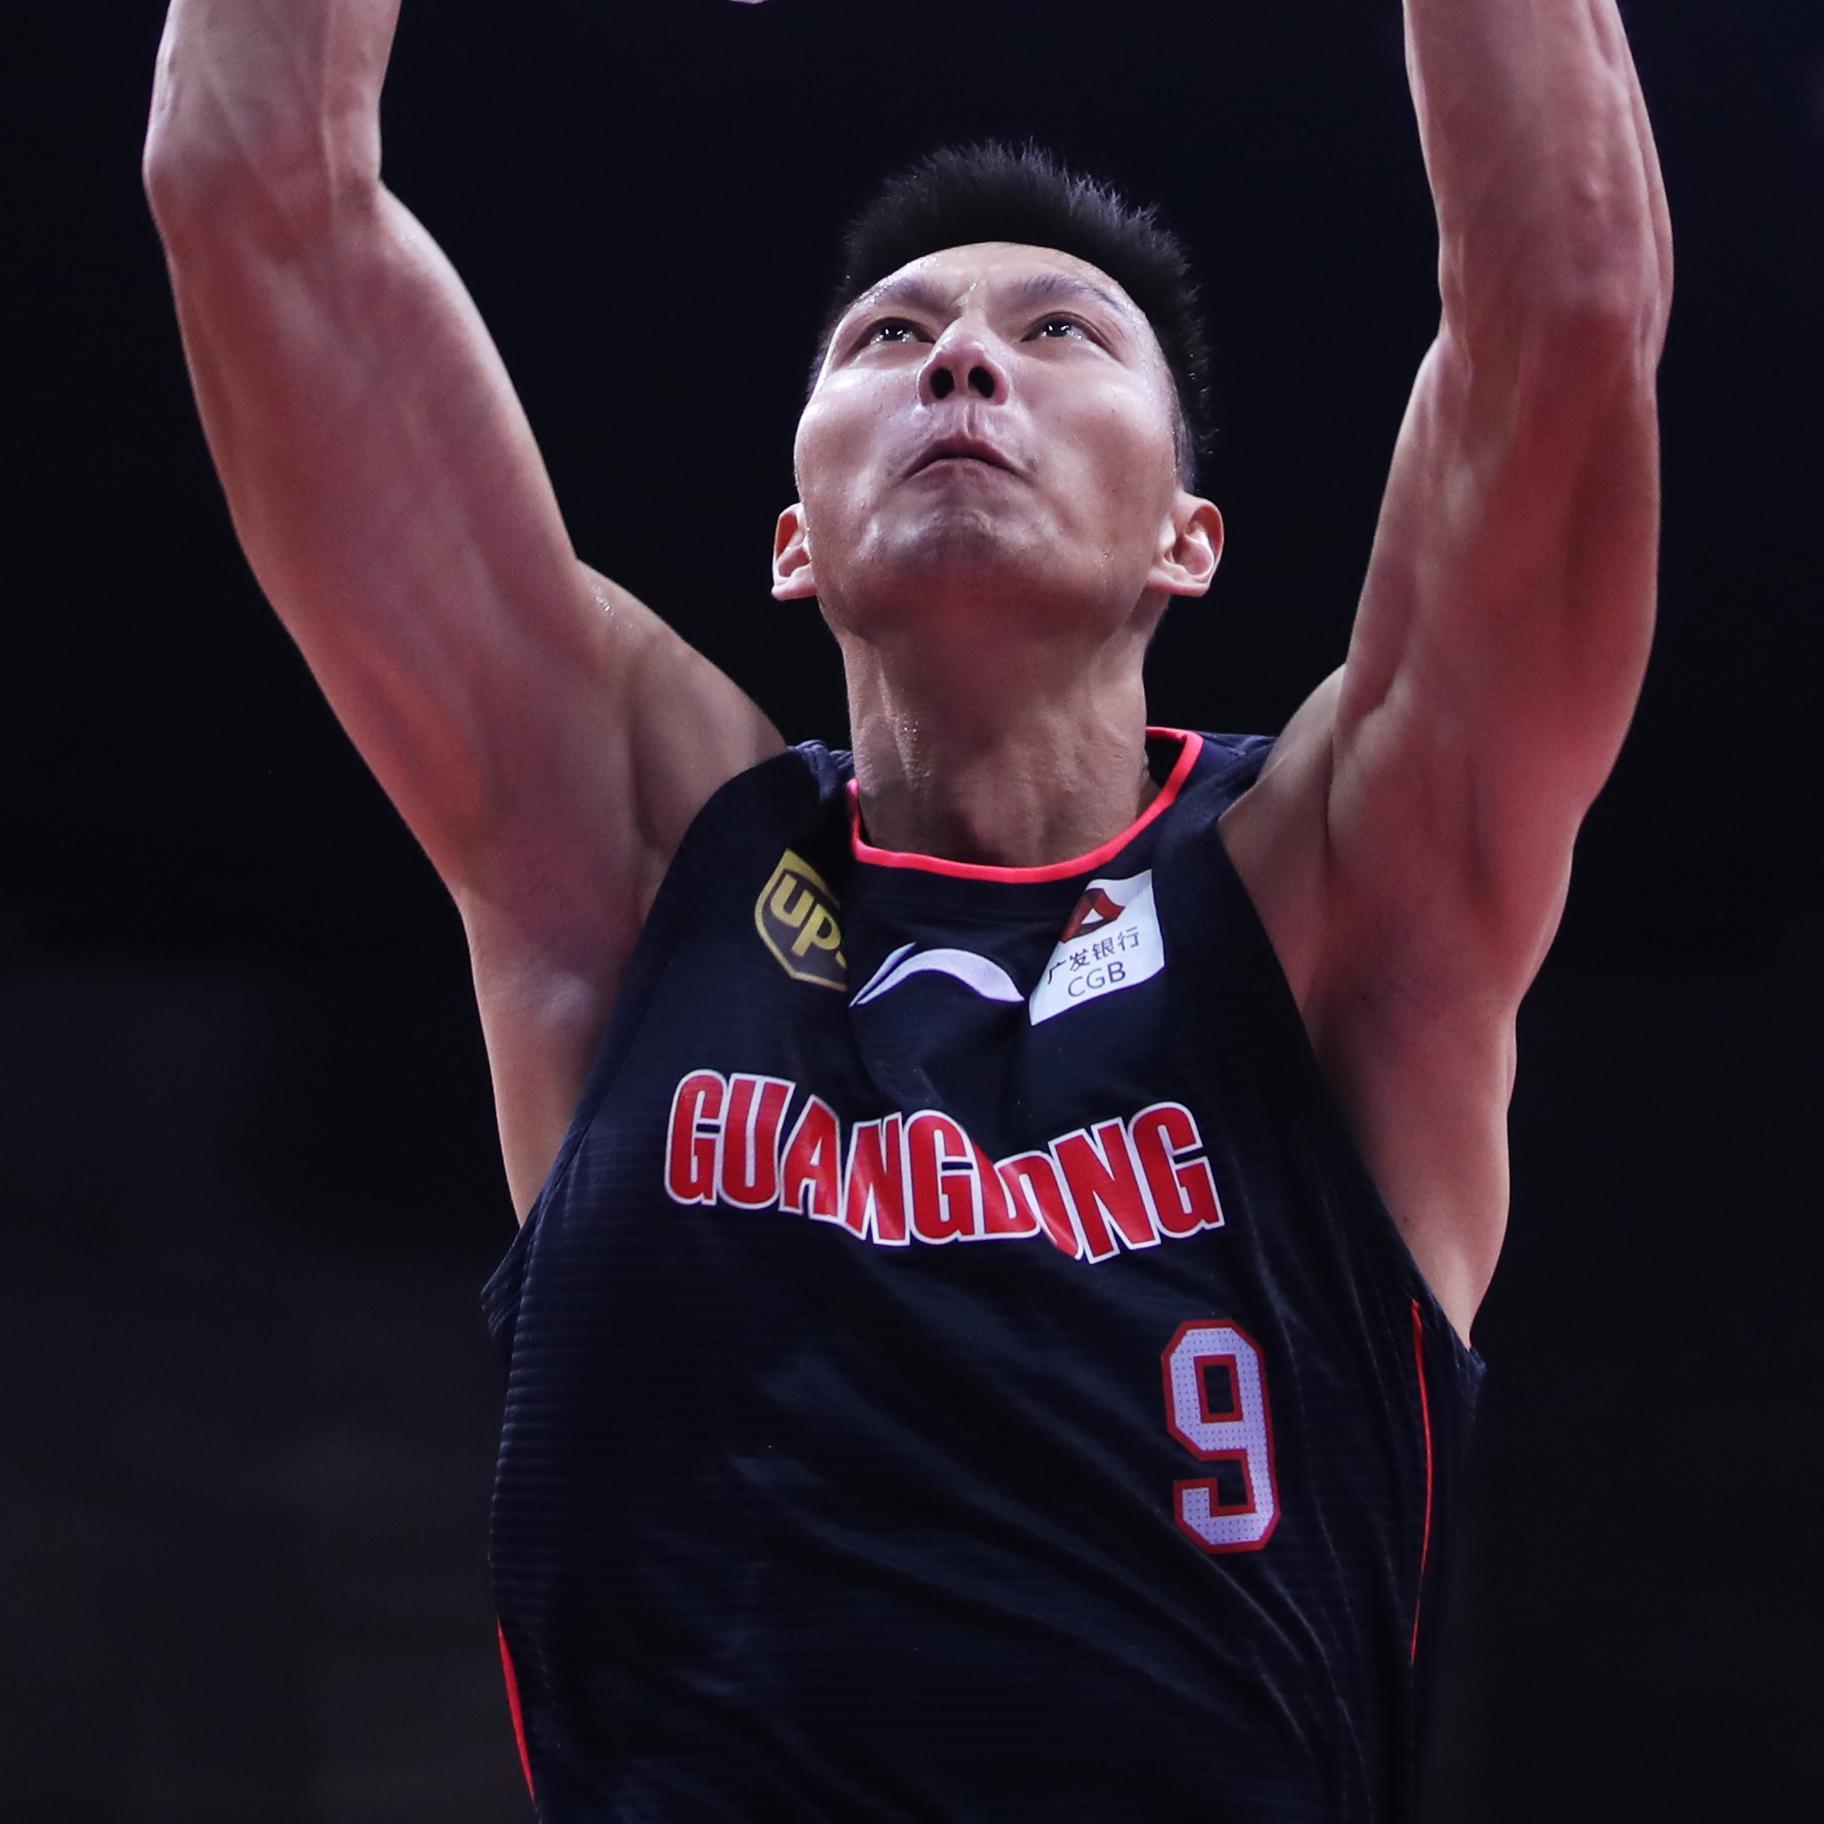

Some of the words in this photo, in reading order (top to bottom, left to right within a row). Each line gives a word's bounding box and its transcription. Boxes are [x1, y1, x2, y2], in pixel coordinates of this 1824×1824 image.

[770, 873, 848, 970] up
[1047, 925, 1141, 985] 广发银行
[1067, 961, 1126, 998] CGB
[1161, 1319, 1281, 1554] 9
